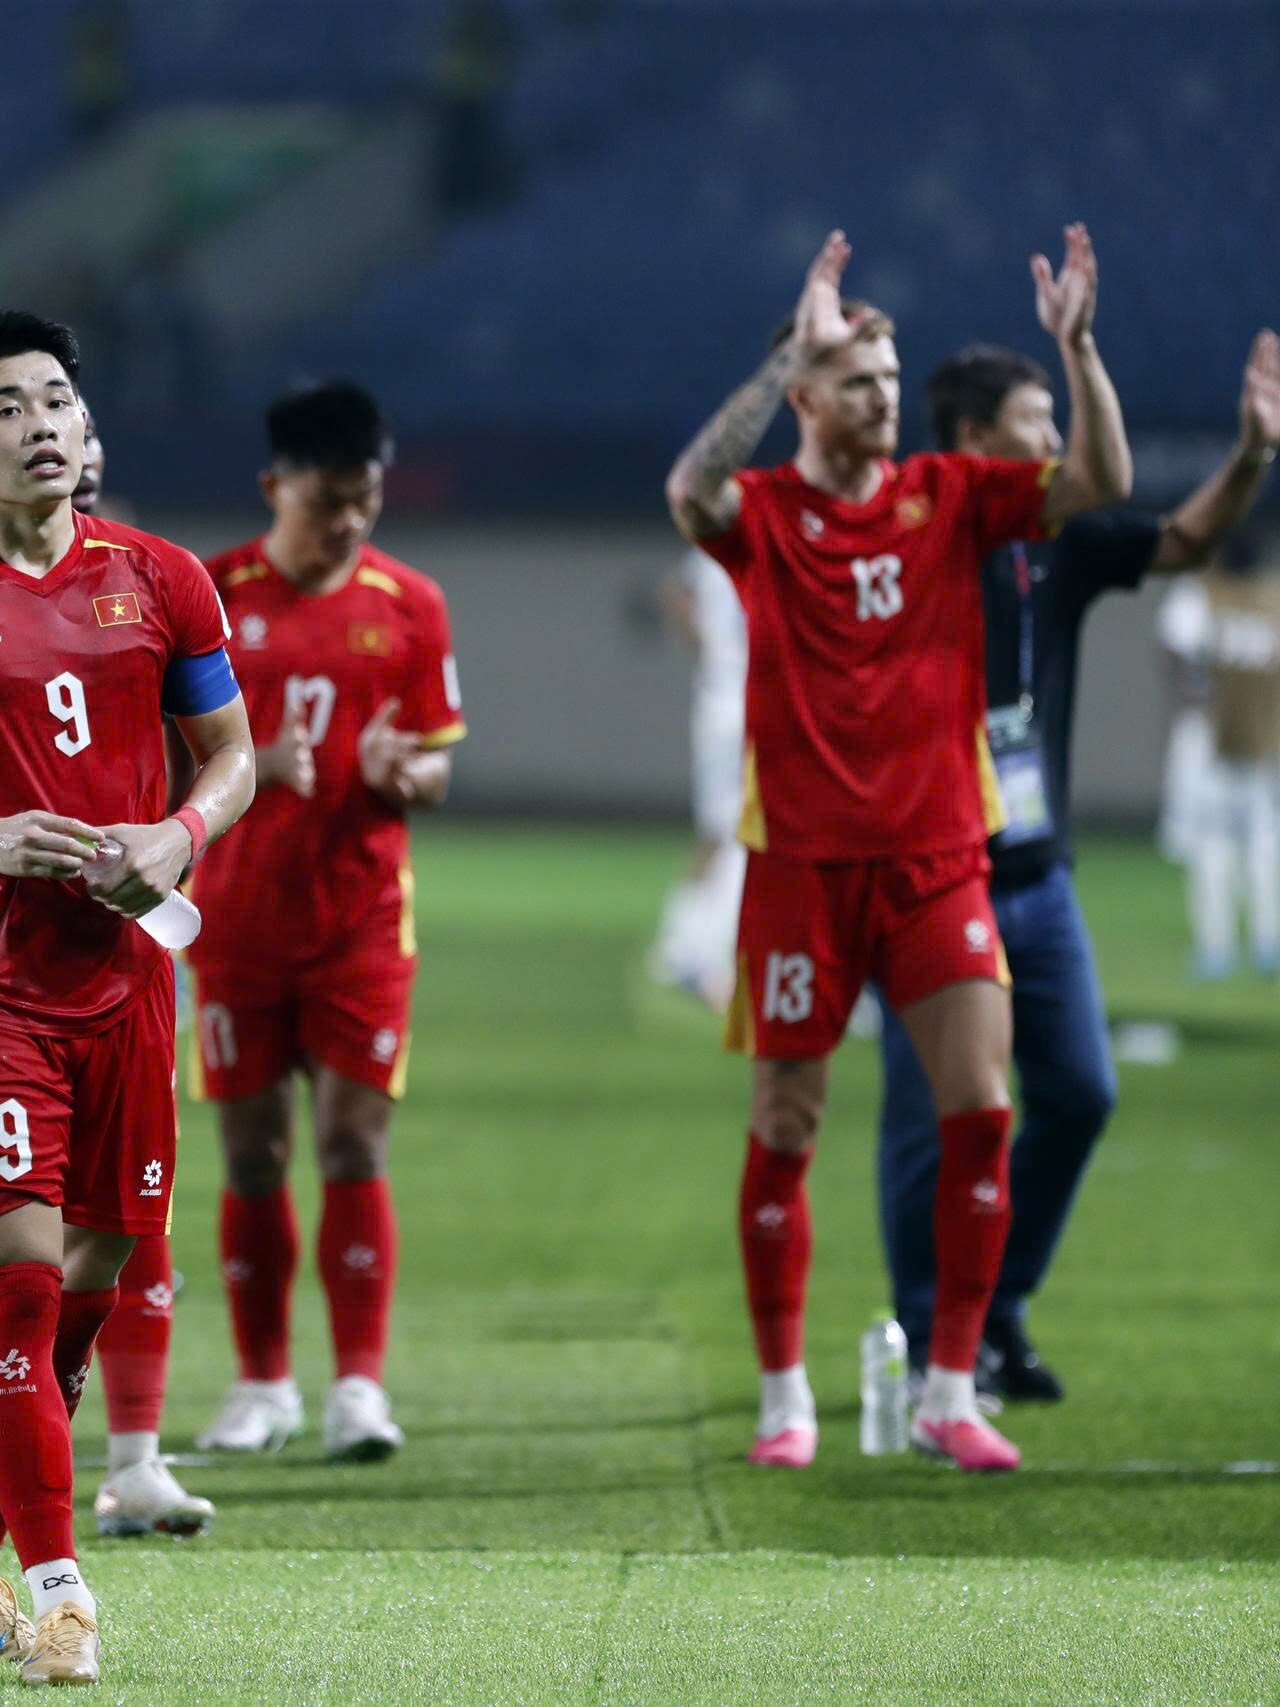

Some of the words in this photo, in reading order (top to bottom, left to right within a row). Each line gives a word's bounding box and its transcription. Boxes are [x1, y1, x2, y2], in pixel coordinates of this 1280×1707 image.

[851, 553, 903, 621] 13
[45, 671, 92, 757] 9
[762, 951, 814, 1023] 13
